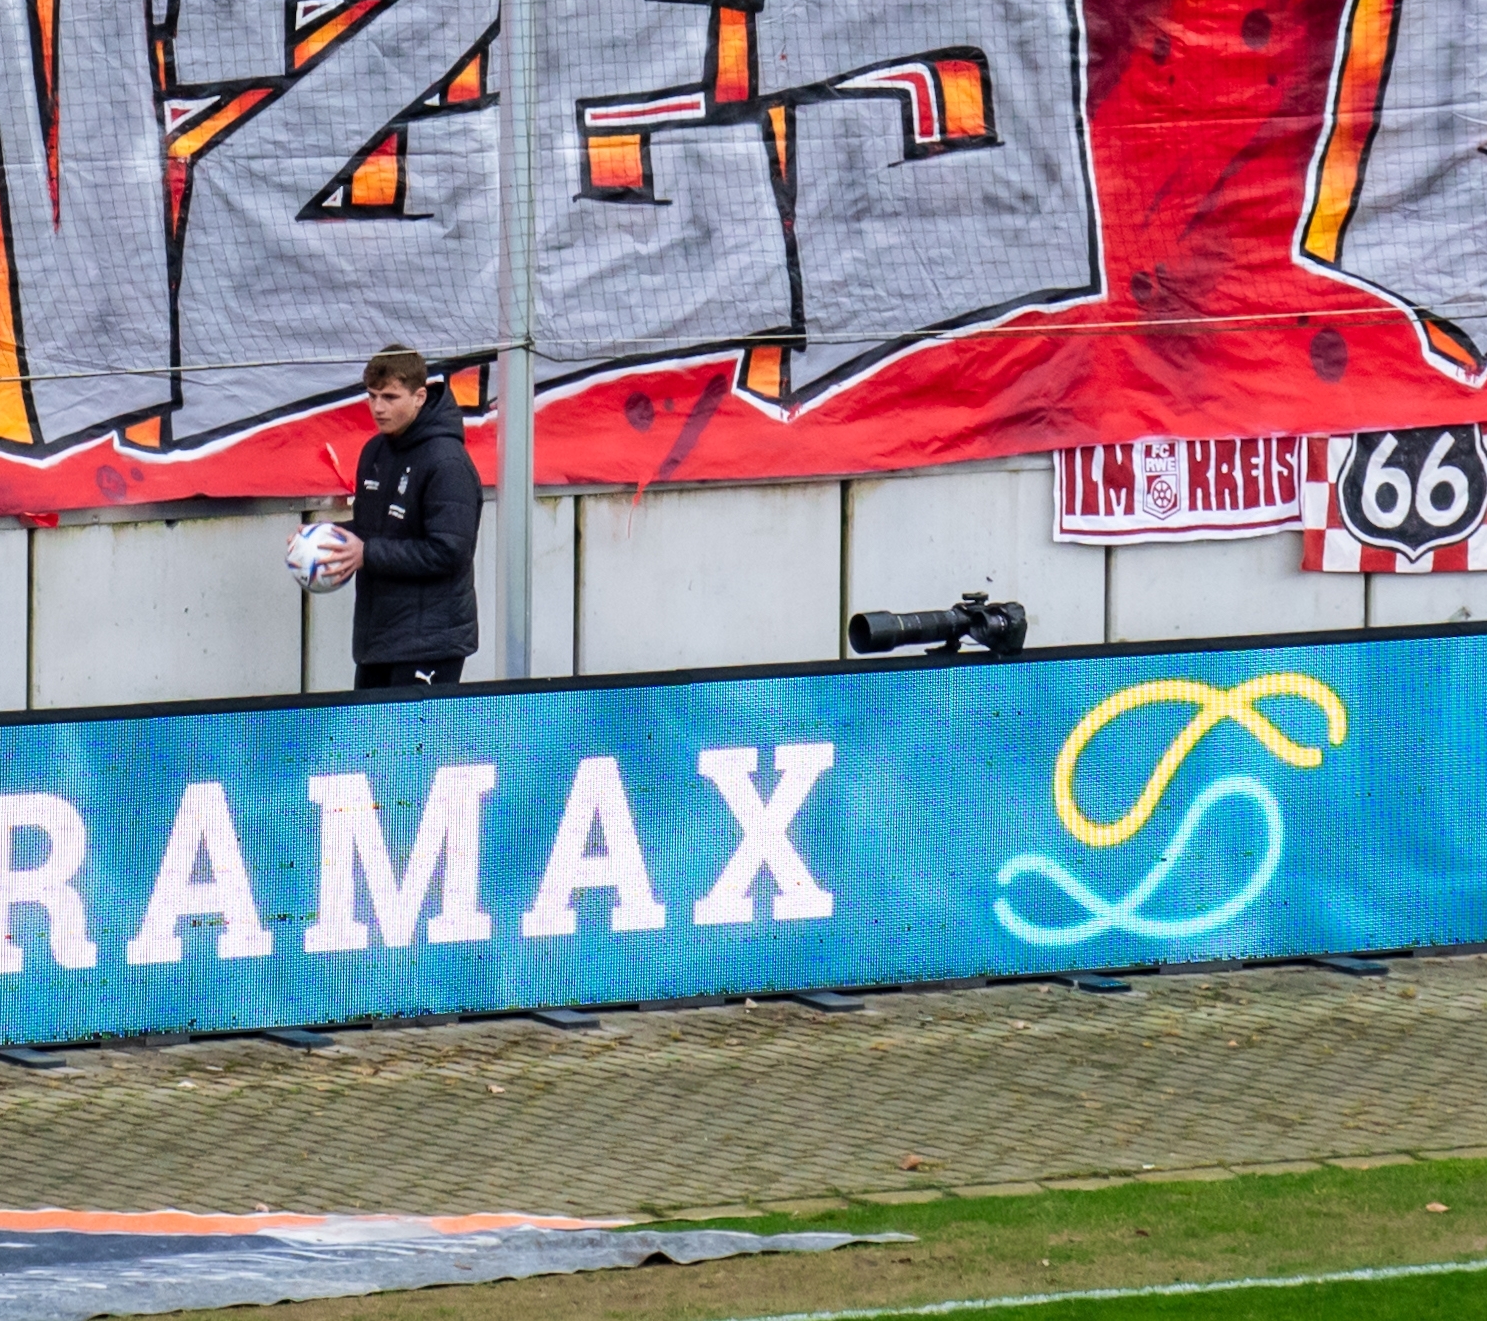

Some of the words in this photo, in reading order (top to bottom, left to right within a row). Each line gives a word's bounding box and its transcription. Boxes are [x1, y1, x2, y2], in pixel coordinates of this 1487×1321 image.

[1145, 457, 1177, 473] RWE
[1150, 443, 1171, 458] FC
[1187, 437, 1300, 513] KREIS
[1360, 431, 1470, 529] 66
